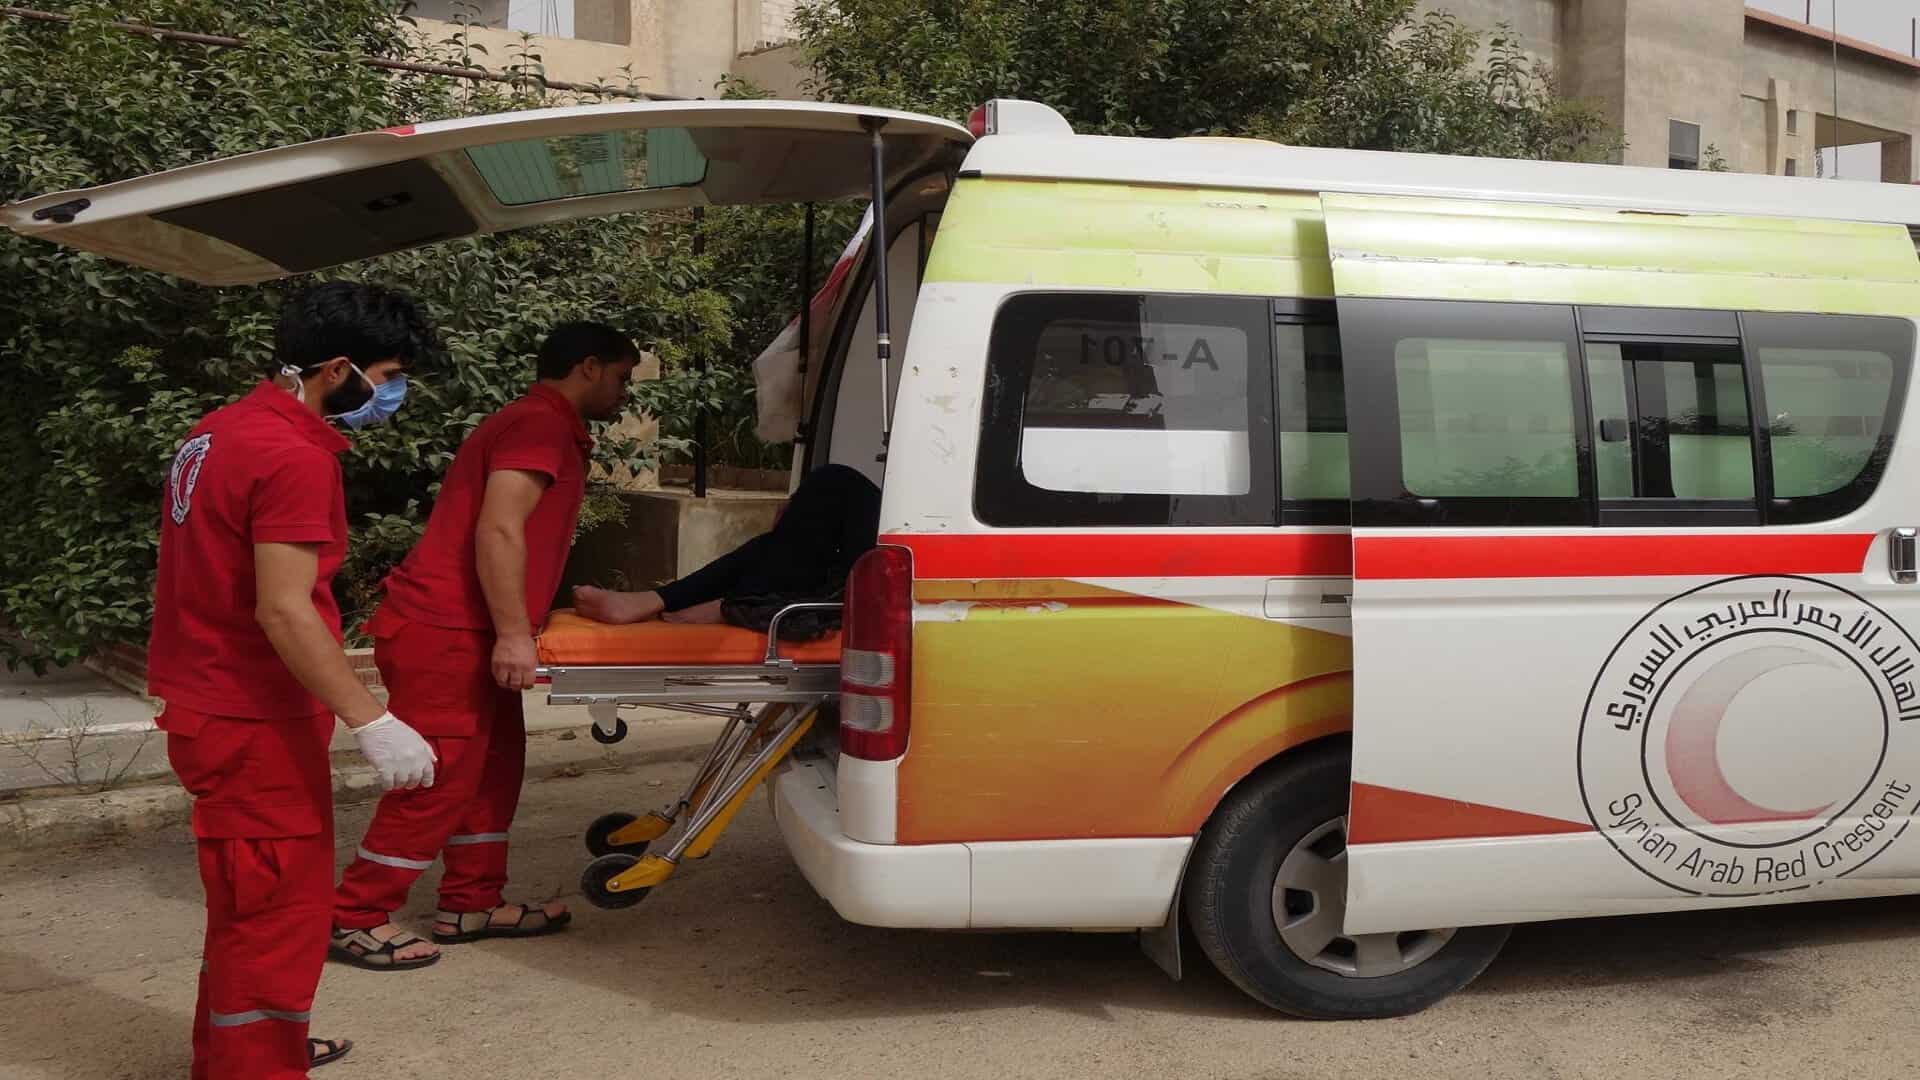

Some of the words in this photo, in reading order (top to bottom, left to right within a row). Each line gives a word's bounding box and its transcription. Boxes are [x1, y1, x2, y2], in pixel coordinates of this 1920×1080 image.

[1684, 589, 1791, 641] العربي
[1606, 623, 1684, 731] السوري
[1869, 645, 1920, 721] الهلال
[1608, 793, 1677, 863] Syrian
[1675, 847, 1744, 885] Arab
[1753, 850, 1806, 885] Red
[1813, 779, 1911, 868] Crescent
